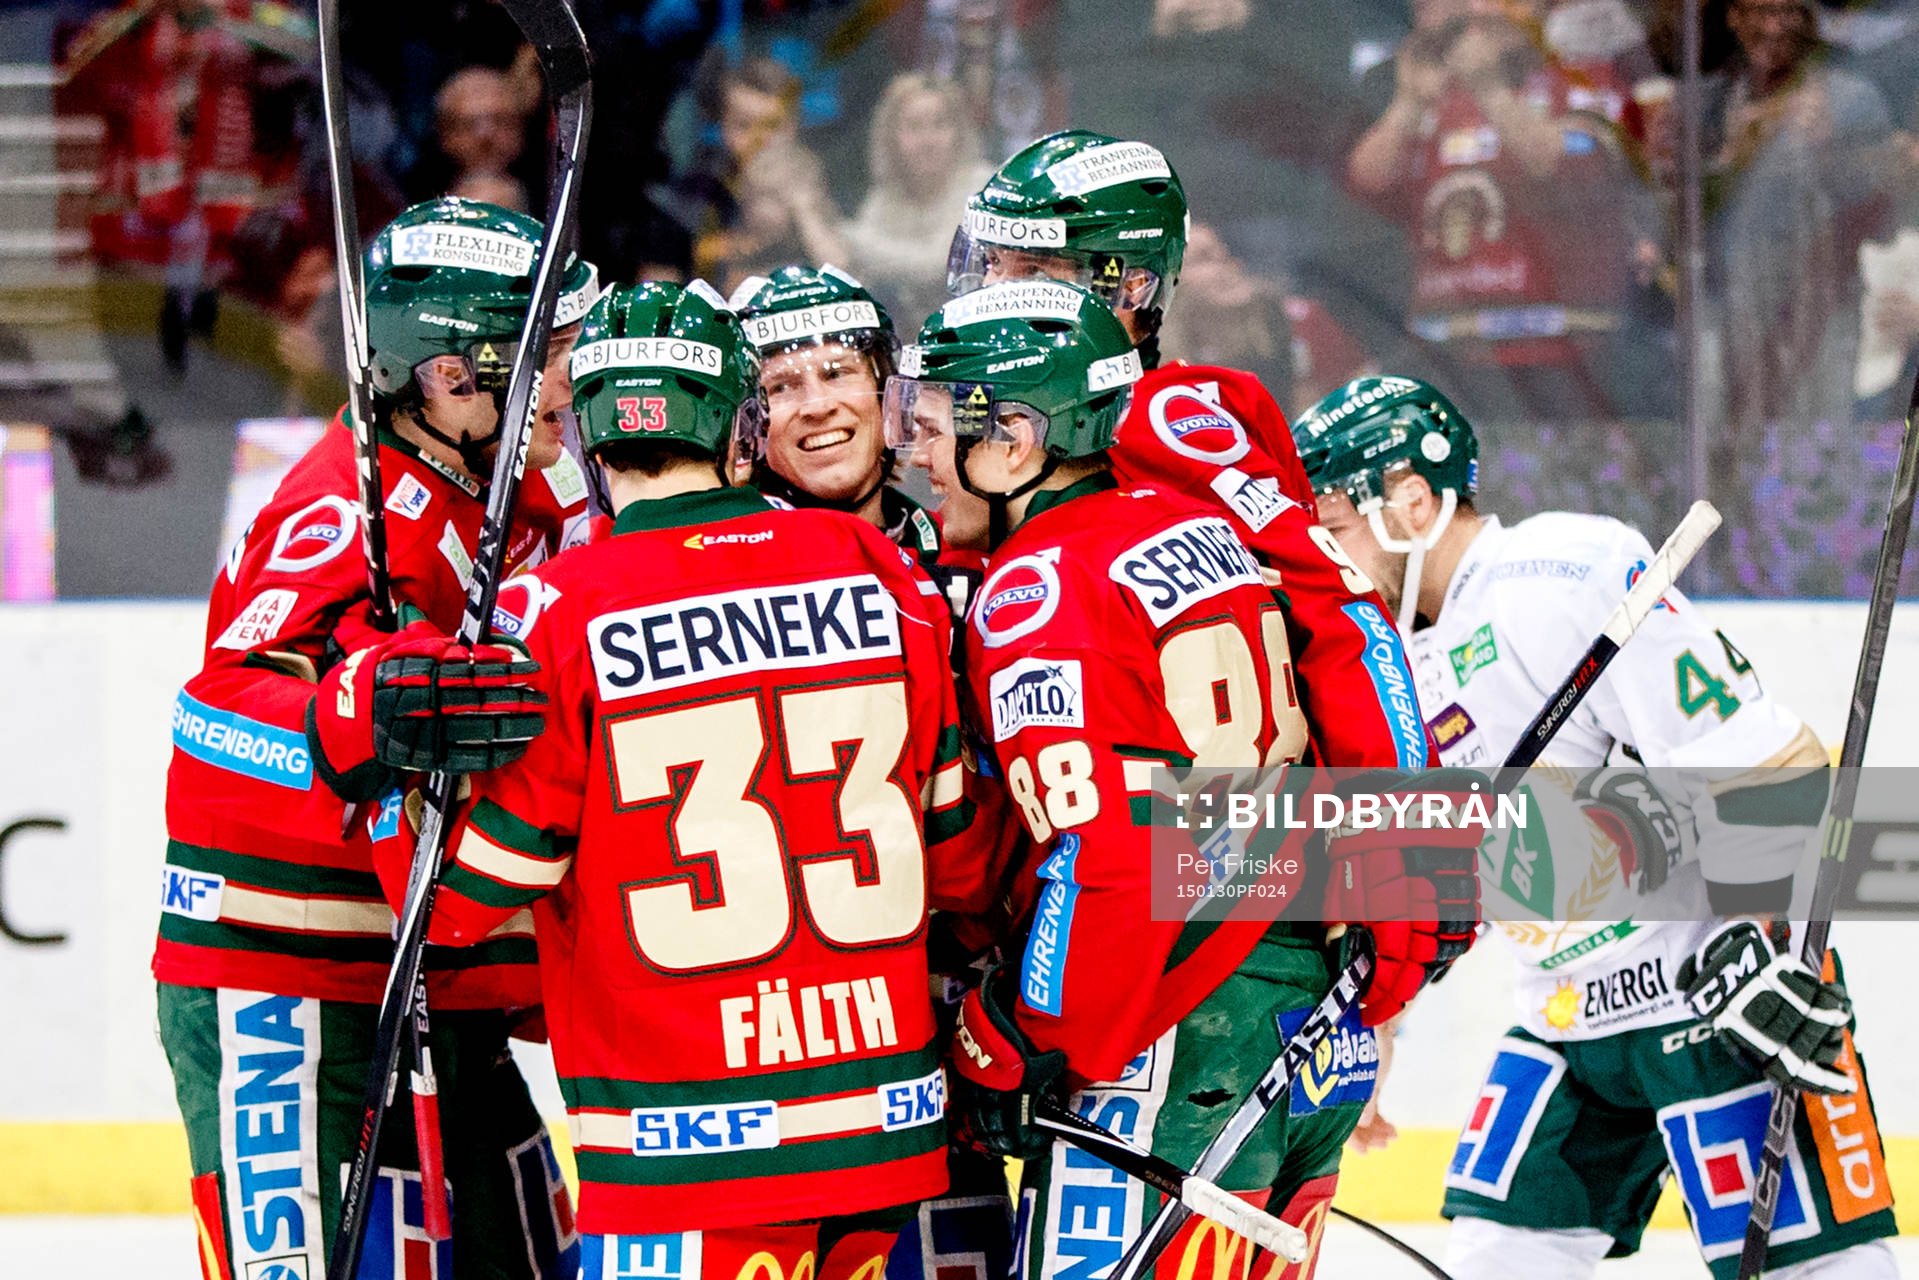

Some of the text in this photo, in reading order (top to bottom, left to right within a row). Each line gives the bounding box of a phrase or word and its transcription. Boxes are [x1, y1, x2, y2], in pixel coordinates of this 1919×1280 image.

[1088, 158, 1168, 183] BEMANNING
[435, 232, 527, 260] FLEXLIFE
[1117, 228, 1164, 240] EASTON
[432, 248, 525, 272] KONSULTING
[975, 298, 1078, 315] BEMANNING
[978, 287, 1079, 303] TRANPENAD
[418, 312, 479, 333] EASTON
[756, 303, 876, 340] BJURFORS
[593, 341, 718, 369] BJURFORS
[986, 354, 1046, 375] EASTON
[615, 378, 663, 387] EASTON
[514, 370, 544, 481] EASTON
[616, 395, 668, 432] 33
[1172, 415, 1231, 434] VOLVO
[703, 530, 774, 545] EASTON
[982, 585, 1046, 617] VOLVO
[600, 583, 891, 689] SERNEKE
[1356, 603, 1423, 778] EHRENBORG
[171, 701, 309, 775] EHRENBORG
[1007, 740, 1100, 844] 88
[600, 671, 929, 979] 33
[1026, 834, 1077, 1008] EHRENBRG
[1584, 957, 1670, 1019] ENERGI
[720, 975, 899, 1070] FÄLTH
[885, 1073, 944, 1127] SKF
[235, 994, 306, 1253] STENA
[635, 1106, 774, 1150] SKF
